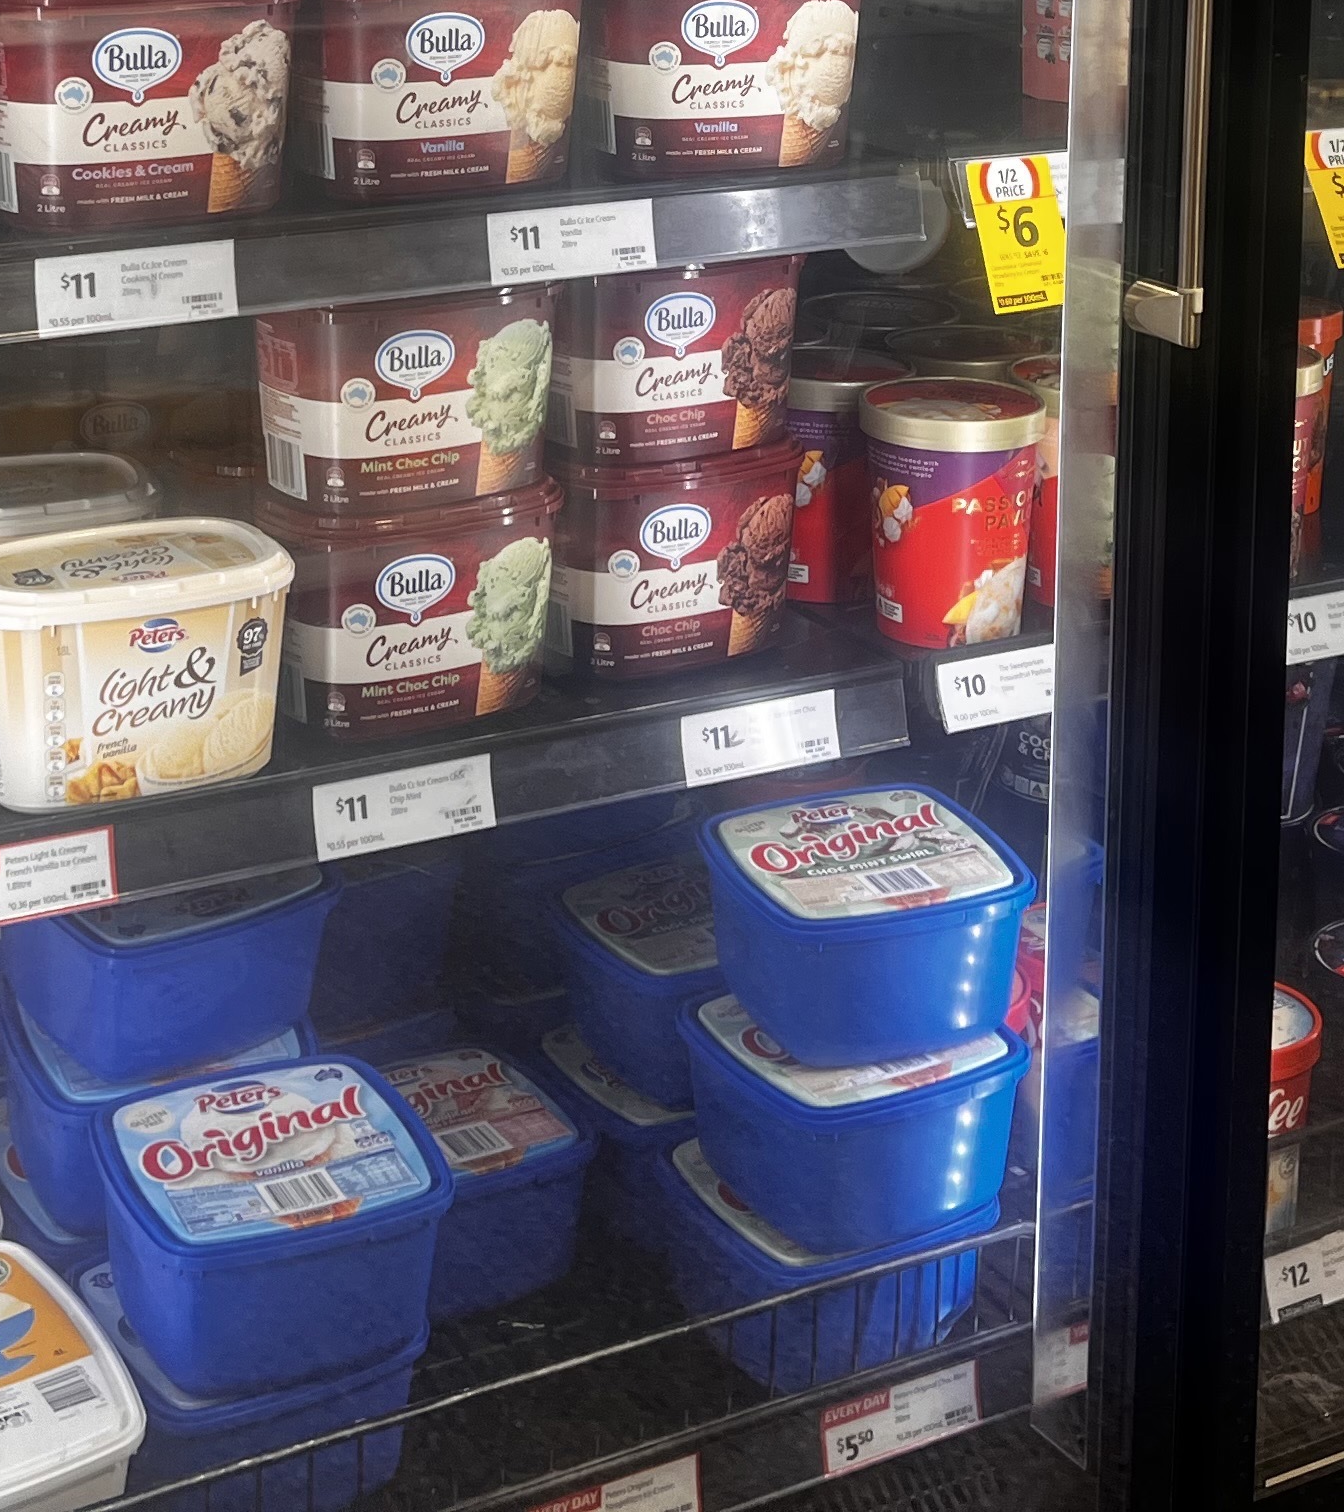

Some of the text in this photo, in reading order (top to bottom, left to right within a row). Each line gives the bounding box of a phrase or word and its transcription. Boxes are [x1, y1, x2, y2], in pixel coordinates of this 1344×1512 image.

[655, 306, 706, 331] Bulla
[635, 361, 714, 398] Creamy
[652, 388, 704, 403] CLASSICS
[646, 407, 706, 425] Choc Chip
[360, 450, 460, 476] Mint Choc Chip
[128, 626, 187, 648] Peters
[99, 646, 217, 705] light &
[92, 684, 218, 738] Creamy
[97, 737, 130, 754] french
[102, 742, 138, 759] vanilla
[792, 802, 863, 825] Peters
[750, 802, 941, 873] Original
[807, 847, 935, 877] CHOC MINT SWIRL
[195, 1084, 282, 1113] Peters
[142, 1085, 366, 1183] Original
[256, 1159, 306, 1178] vanilla
